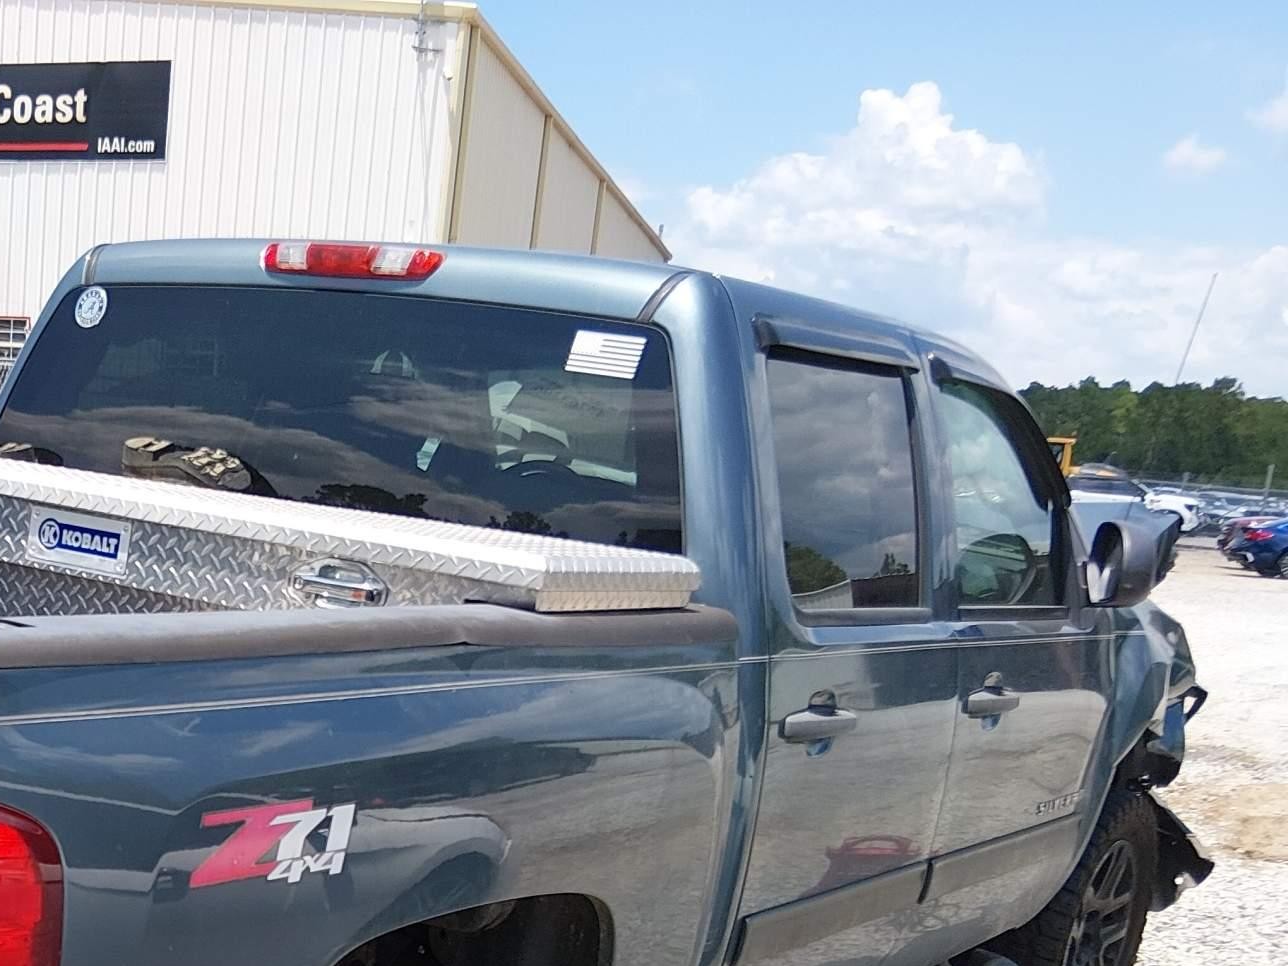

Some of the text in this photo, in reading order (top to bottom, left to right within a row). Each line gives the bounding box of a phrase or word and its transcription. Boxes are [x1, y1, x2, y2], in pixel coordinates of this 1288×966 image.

[97, 137, 155, 153] IAAI.com
[61, 528, 118, 555] KOBALT
[189, 796, 357, 889] Z71
